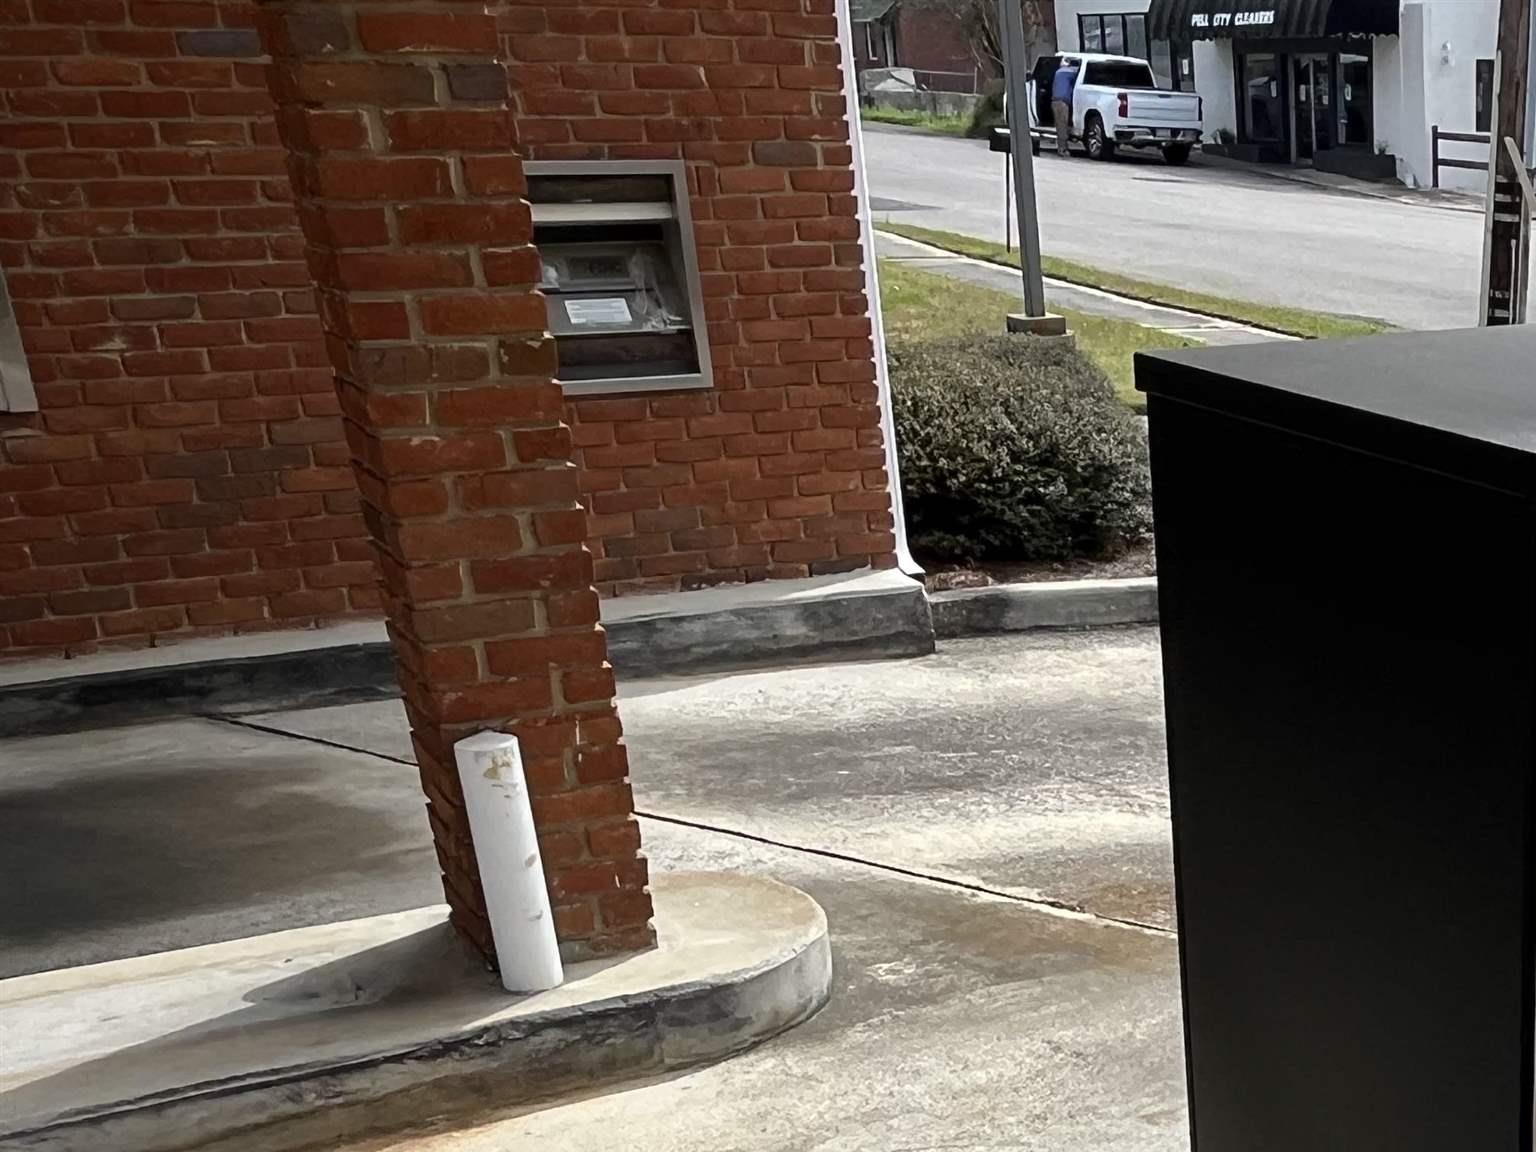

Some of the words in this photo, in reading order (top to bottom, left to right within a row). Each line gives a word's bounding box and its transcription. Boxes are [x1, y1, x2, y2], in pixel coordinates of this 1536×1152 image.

[1191, 13, 1209, 27] PELL
[1213, 13, 1232, 27] CITY
[1234, 10, 1275, 26] CLEANERS
